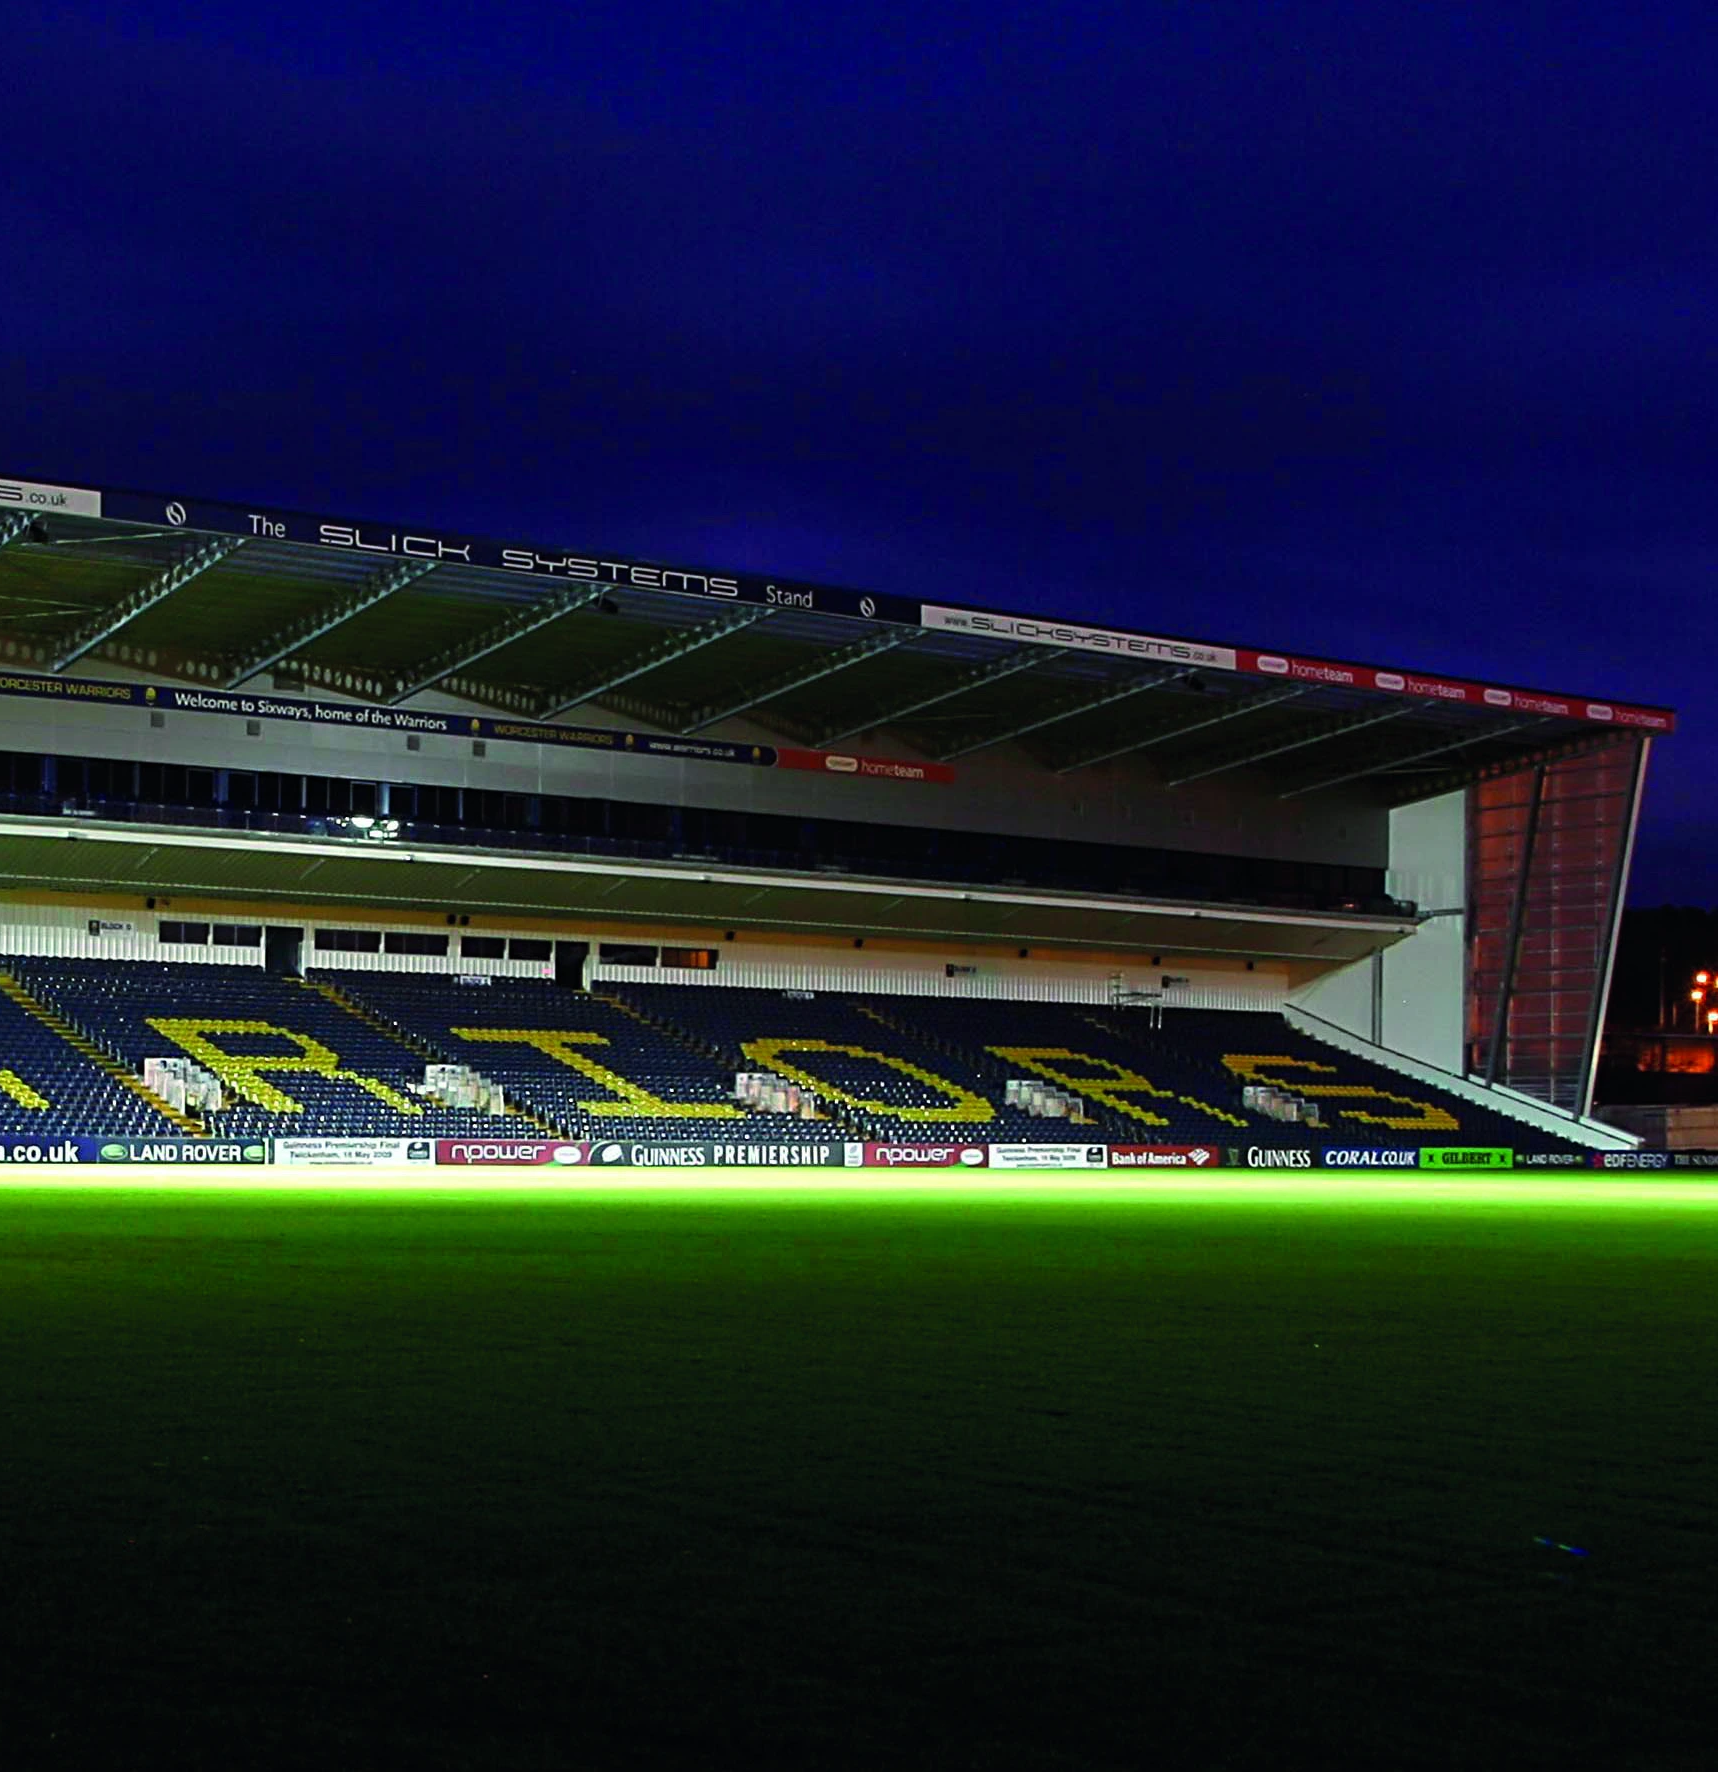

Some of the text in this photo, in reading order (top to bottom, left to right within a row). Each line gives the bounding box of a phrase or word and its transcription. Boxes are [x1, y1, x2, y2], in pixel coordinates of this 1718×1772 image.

[249, 514, 813, 609] The SLICK SYSTEMS Stand
[65, 682, 131, 699] WARRIORS
[175, 692, 237, 712] Welcome
[241, 698, 254, 713] to
[315, 706, 353, 723] home
[355, 709, 370, 724] of
[370, 709, 391, 726] the
[394, 711, 447, 732] Warriors
[130, 1145, 241, 1161] LAND ROVER
[451, 1144, 546, 1164] npower
[631, 1145, 830, 1166] GUINNESS PREMIERSHIP
[875, 1147, 954, 1163] npower
[1112, 1152, 1186, 1166] Bank of America
[1248, 1146, 1311, 1168] GUINNESS
